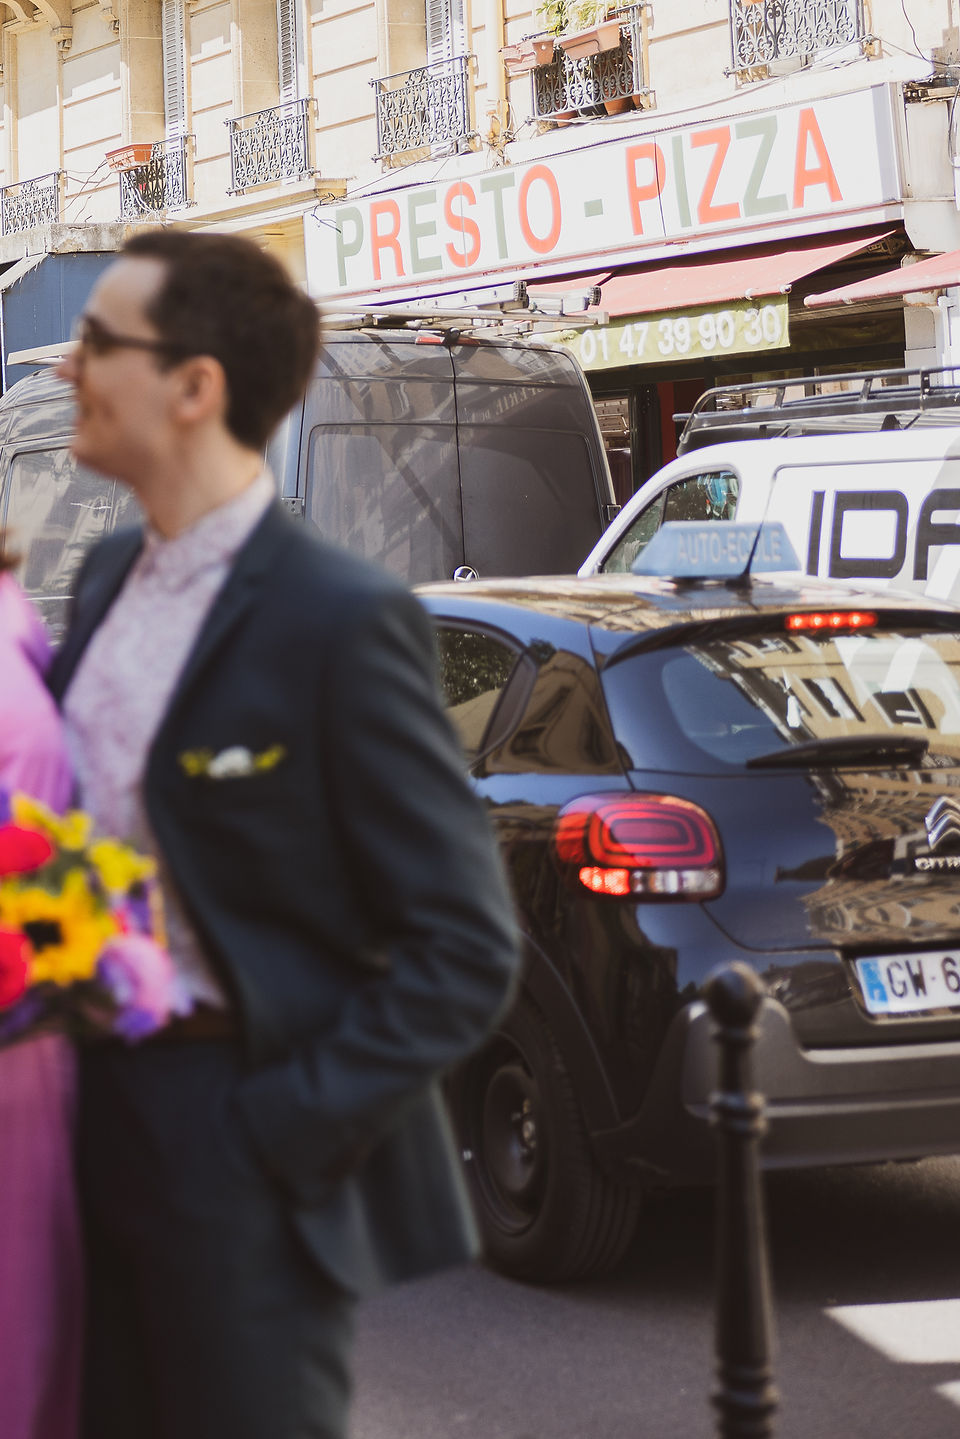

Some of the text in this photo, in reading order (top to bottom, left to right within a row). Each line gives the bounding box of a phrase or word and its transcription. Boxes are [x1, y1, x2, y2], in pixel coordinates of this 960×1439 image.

[335, 164, 562, 287] PRESTO
[625, 107, 844, 236] PIZZA
[580, 328, 609, 364] 01
[619, 322, 648, 358] 47
[657, 317, 691, 355] 39
[698, 310, 735, 350] 90
